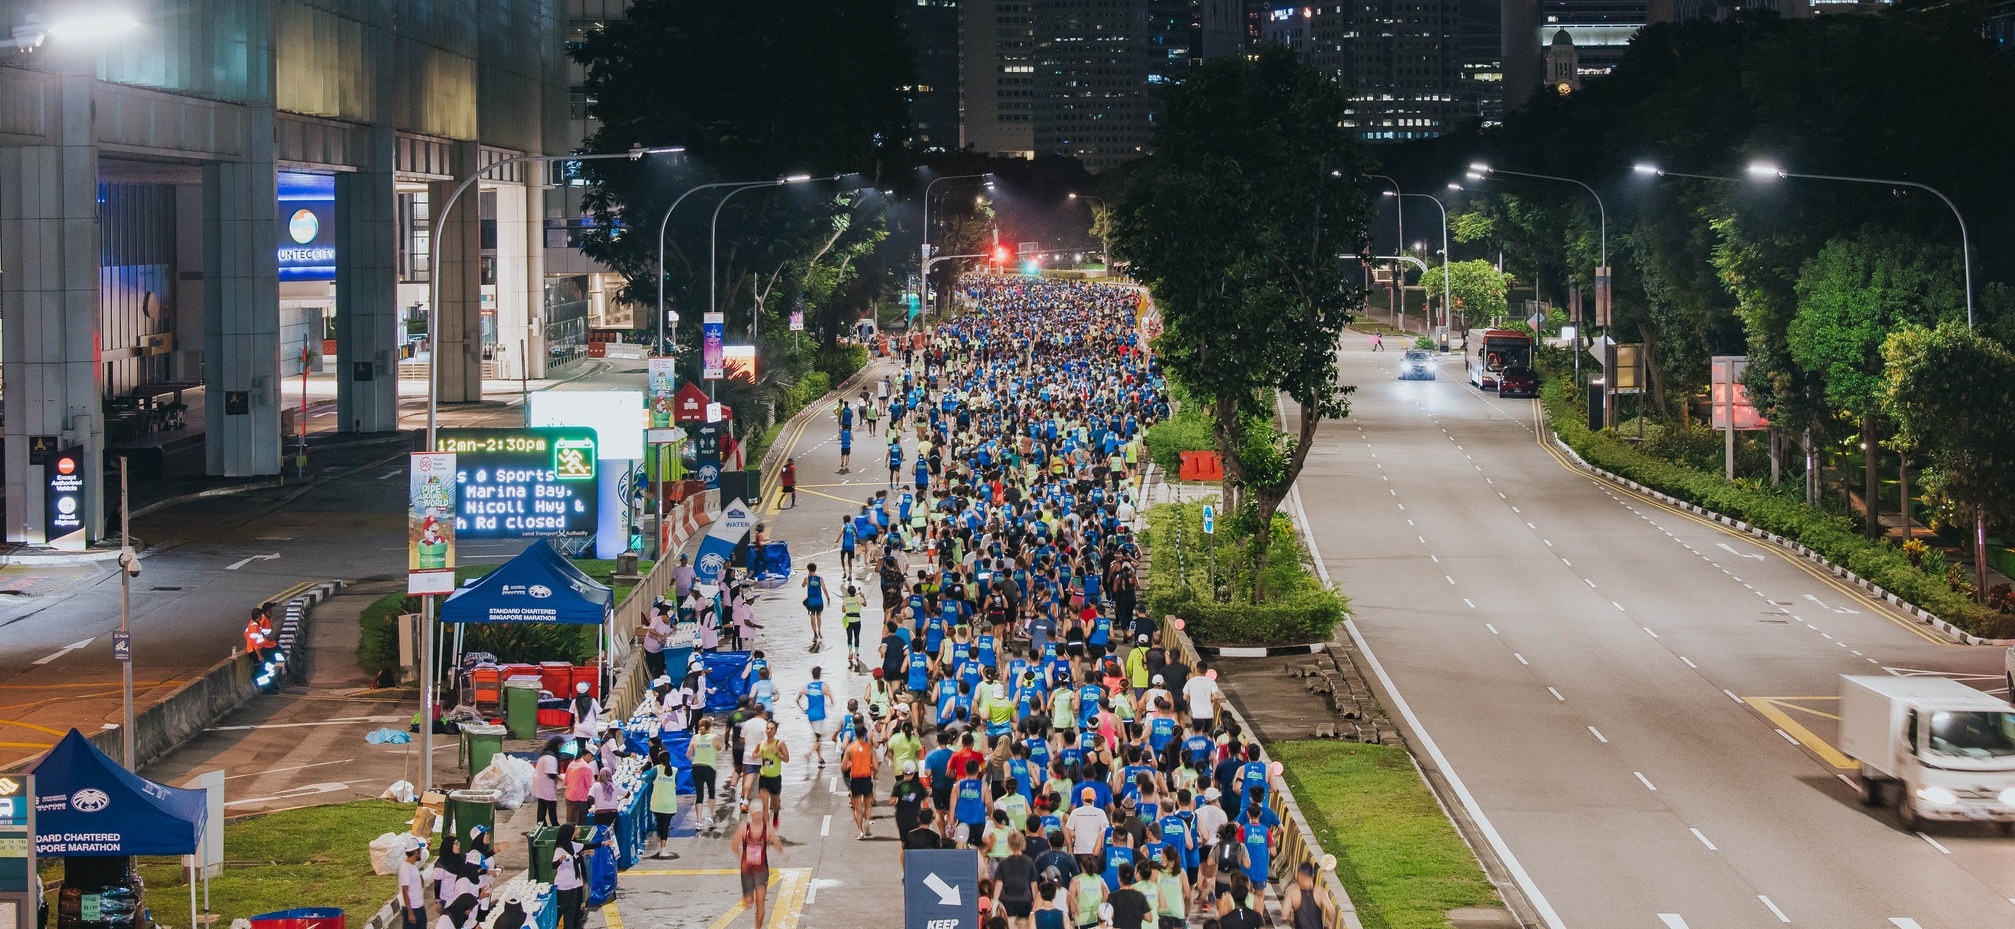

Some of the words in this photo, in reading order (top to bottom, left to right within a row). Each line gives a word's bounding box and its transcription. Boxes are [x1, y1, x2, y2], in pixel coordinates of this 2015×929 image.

[279, 250, 312, 259] UNTEC
[314, 250, 335, 259] CITY
[438, 439, 546, 452] 12mn-2:30pm
[496, 469, 555, 483] Sports
[421, 484, 442, 494] PIPE
[466, 485, 526, 498] Marina
[535, 484, 573, 498] Bay,
[423, 499, 449, 507] WORLD
[466, 501, 525, 514] Nicoll
[535, 500, 565, 514] Hwy
[574, 499, 585, 512] &
[476, 516, 496, 529] Rd
[506, 516, 565, 529] closed
[63, 833, 121, 842] CHARTERED
[68, 843, 120, 852] MARATHON
